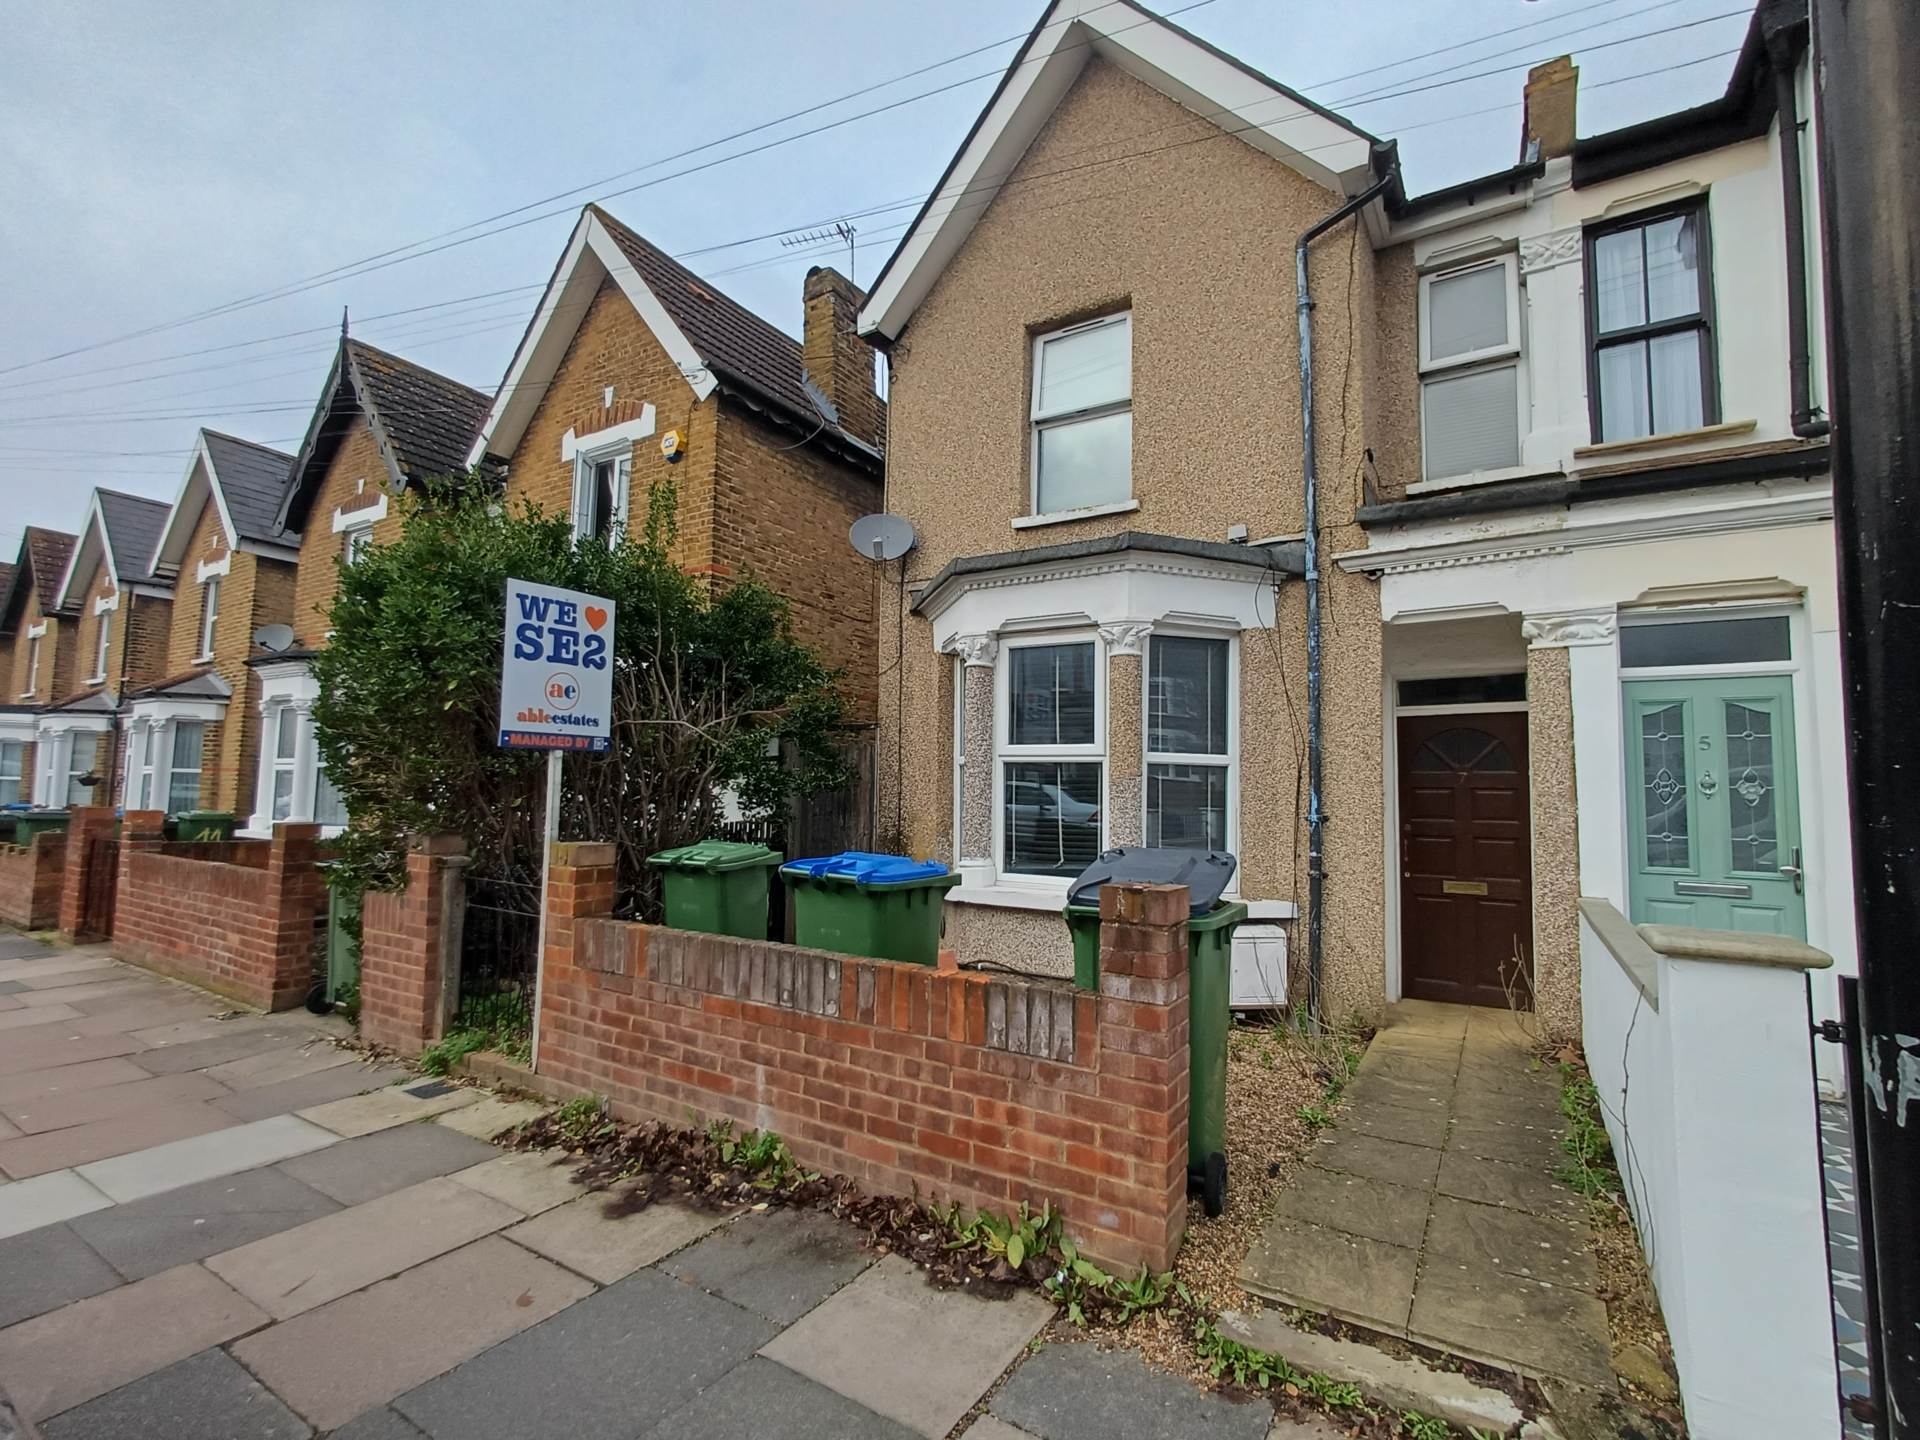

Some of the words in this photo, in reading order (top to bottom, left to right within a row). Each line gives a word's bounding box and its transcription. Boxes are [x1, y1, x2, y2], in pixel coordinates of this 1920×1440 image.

[516, 593, 577, 627] WE
[514, 623, 607, 670] SE2
[549, 683, 576, 699] ae
[510, 733, 572, 747] MANAGED
[575, 737, 590, 748] BY
[1698, 735, 1711, 751] 5
